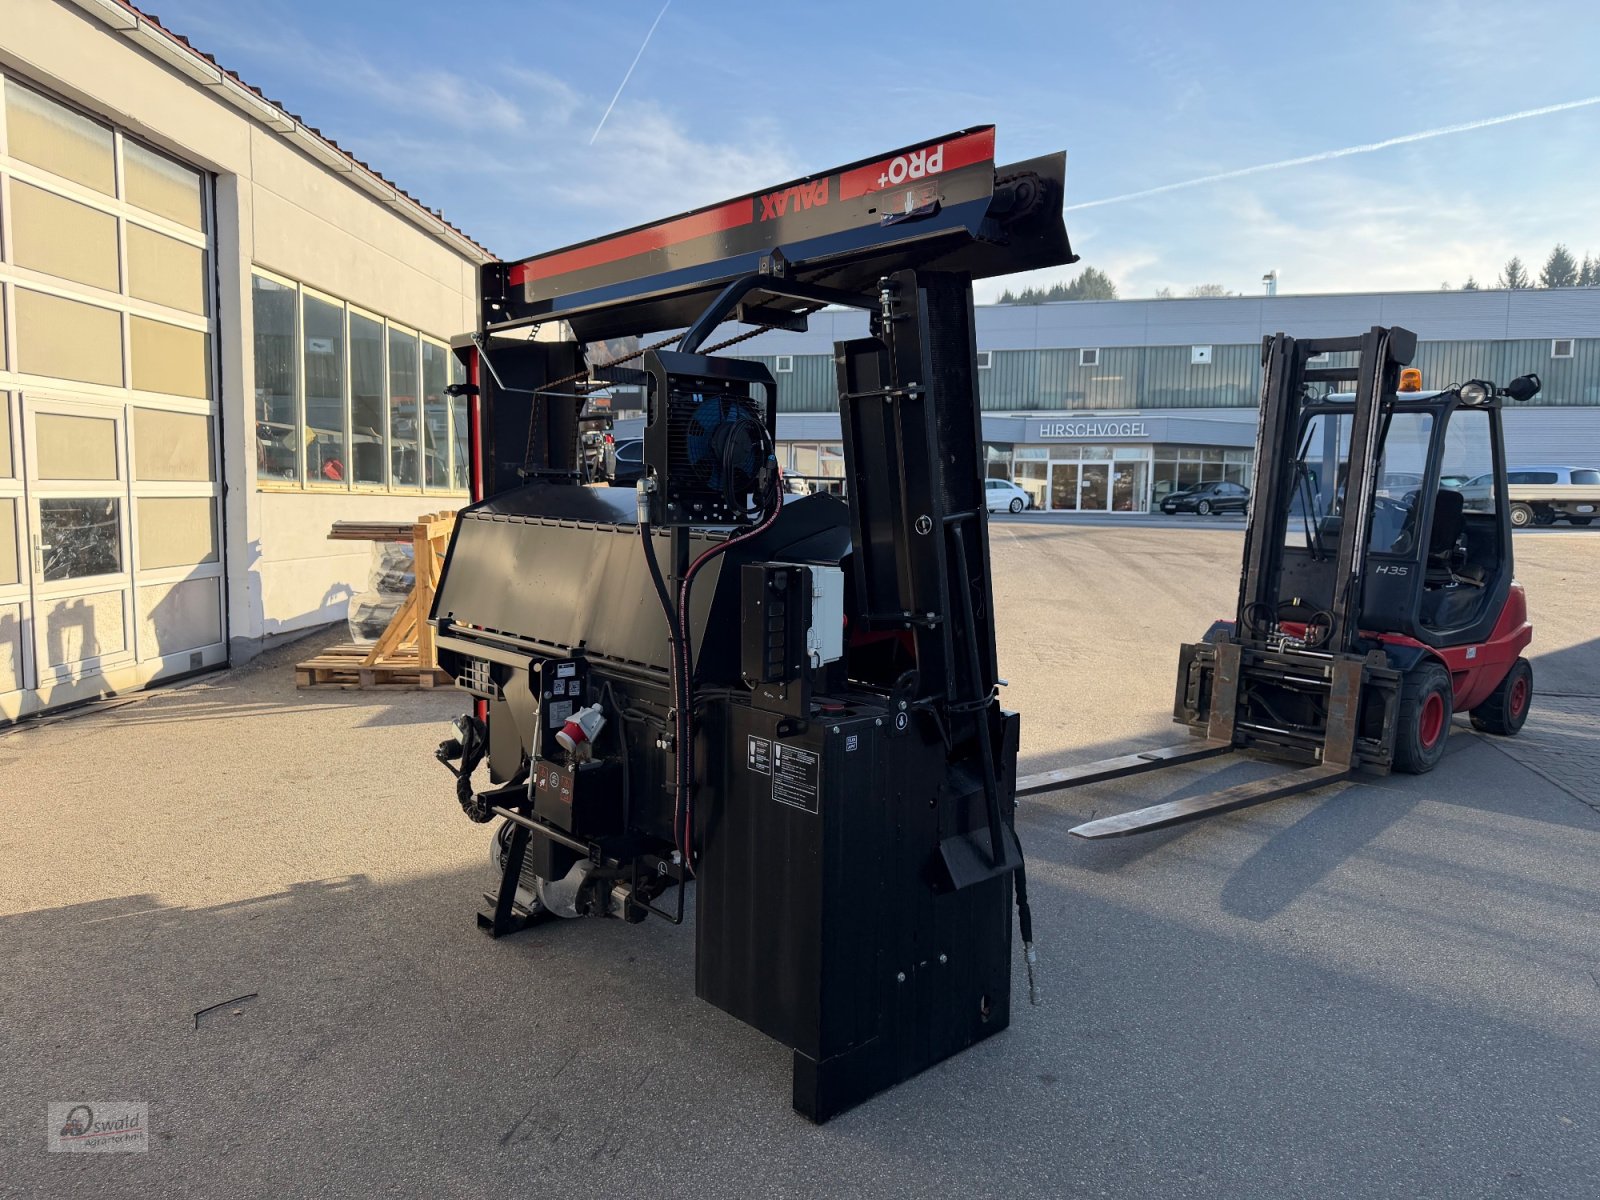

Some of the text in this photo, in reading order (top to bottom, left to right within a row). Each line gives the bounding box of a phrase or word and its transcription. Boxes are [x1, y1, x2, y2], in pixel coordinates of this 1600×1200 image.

[877, 144, 944, 187] PRO+
[760, 176, 829, 222] PALAX
[1040, 423, 1149, 437] HIRSCHVOGEL
